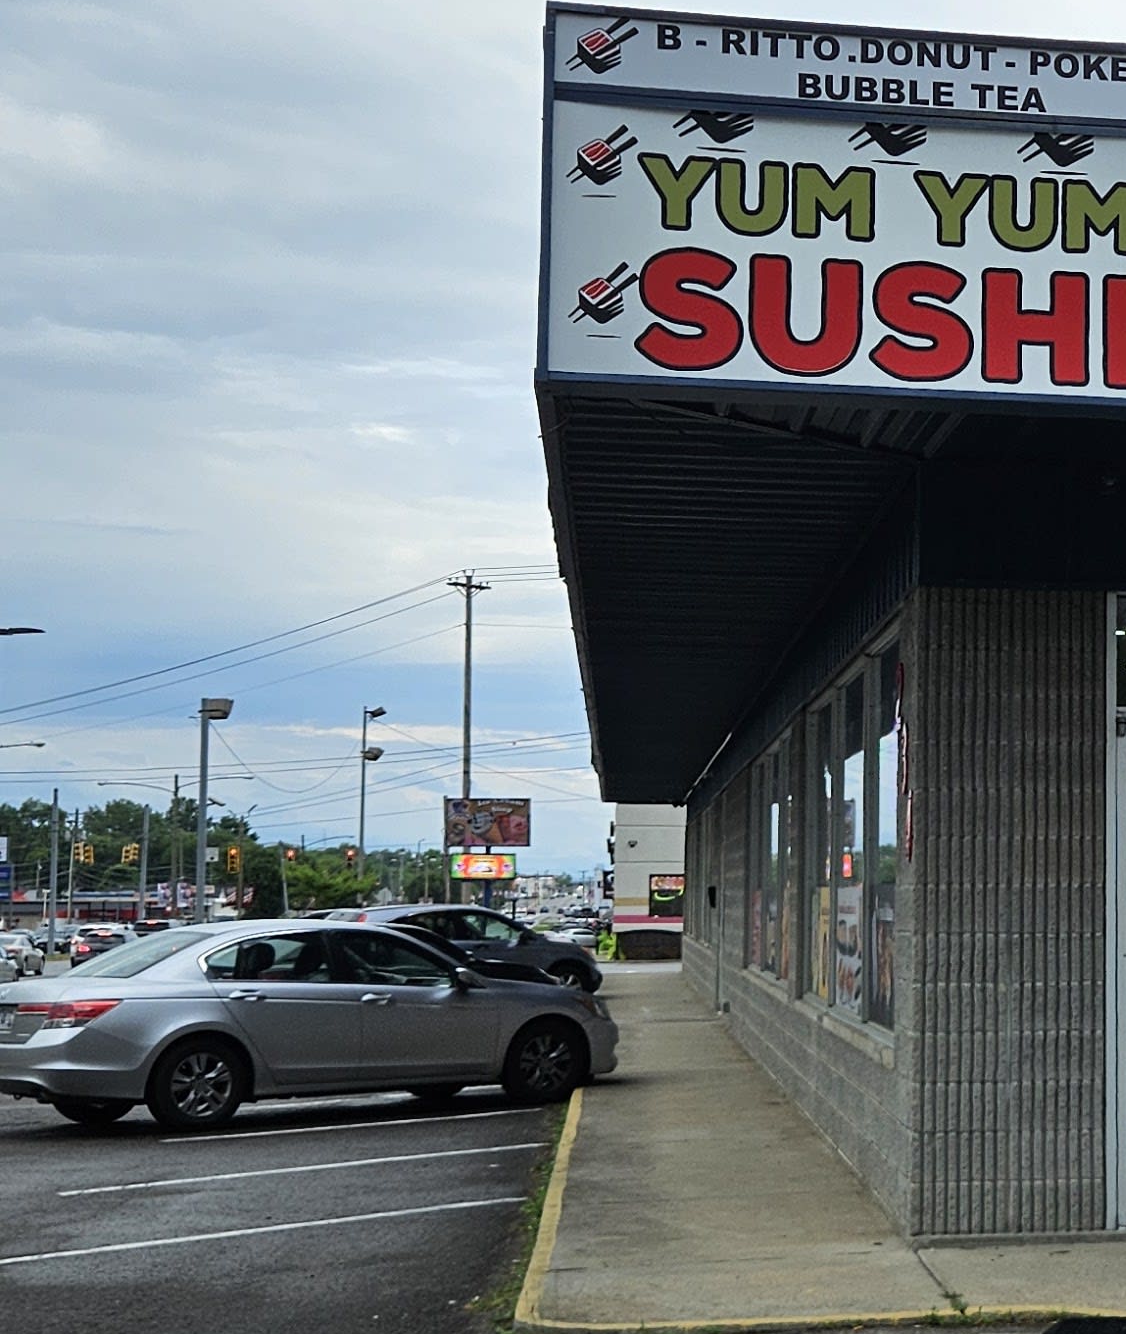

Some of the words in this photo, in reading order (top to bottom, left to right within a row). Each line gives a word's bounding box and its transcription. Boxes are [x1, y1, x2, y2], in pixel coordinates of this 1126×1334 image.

[657, 24, 682, 50] B
[721, 28, 841, 61] RITTO
[798, 72, 954, 107] BUBBLE
[971, 83, 1047, 113] TEA
[638, 153, 876, 241] YUM
